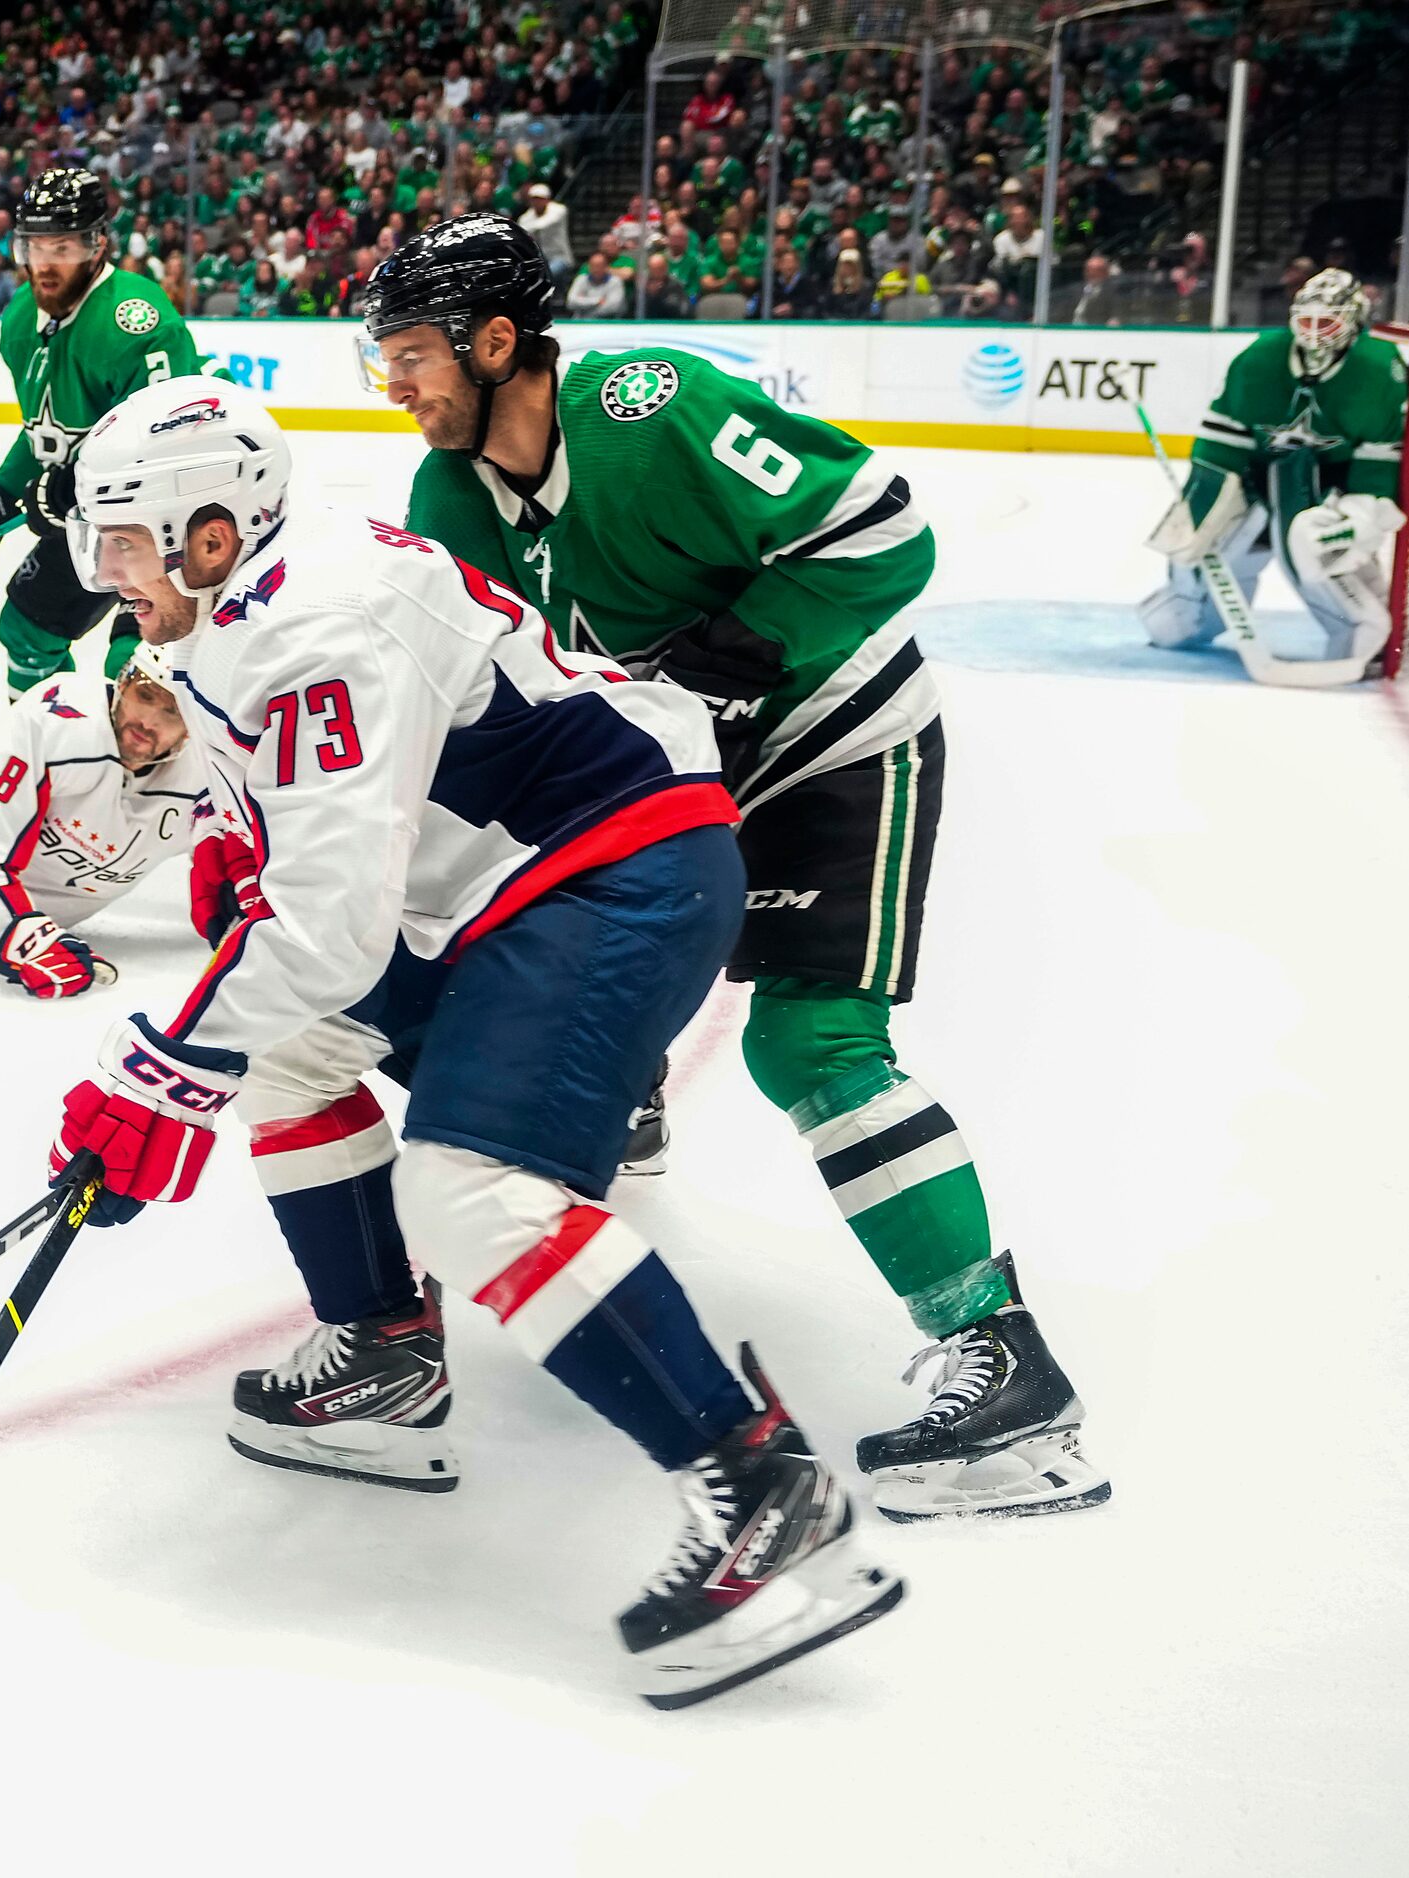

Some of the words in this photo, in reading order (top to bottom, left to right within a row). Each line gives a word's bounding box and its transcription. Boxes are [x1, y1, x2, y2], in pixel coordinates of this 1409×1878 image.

[145, 350, 171, 386] 2
[209, 353, 279, 391] RT
[755, 367, 805, 403] nk
[1039, 359, 1157, 400] AT&T
[710, 413, 803, 496] 6
[365, 516, 434, 553] SH
[264, 679, 363, 787] 73
[159, 808, 179, 841] C
[39, 817, 147, 887] apitals
[744, 889, 822, 910] CM
[16, 921, 57, 959] CC
[323, 1382, 380, 1413] CCM
